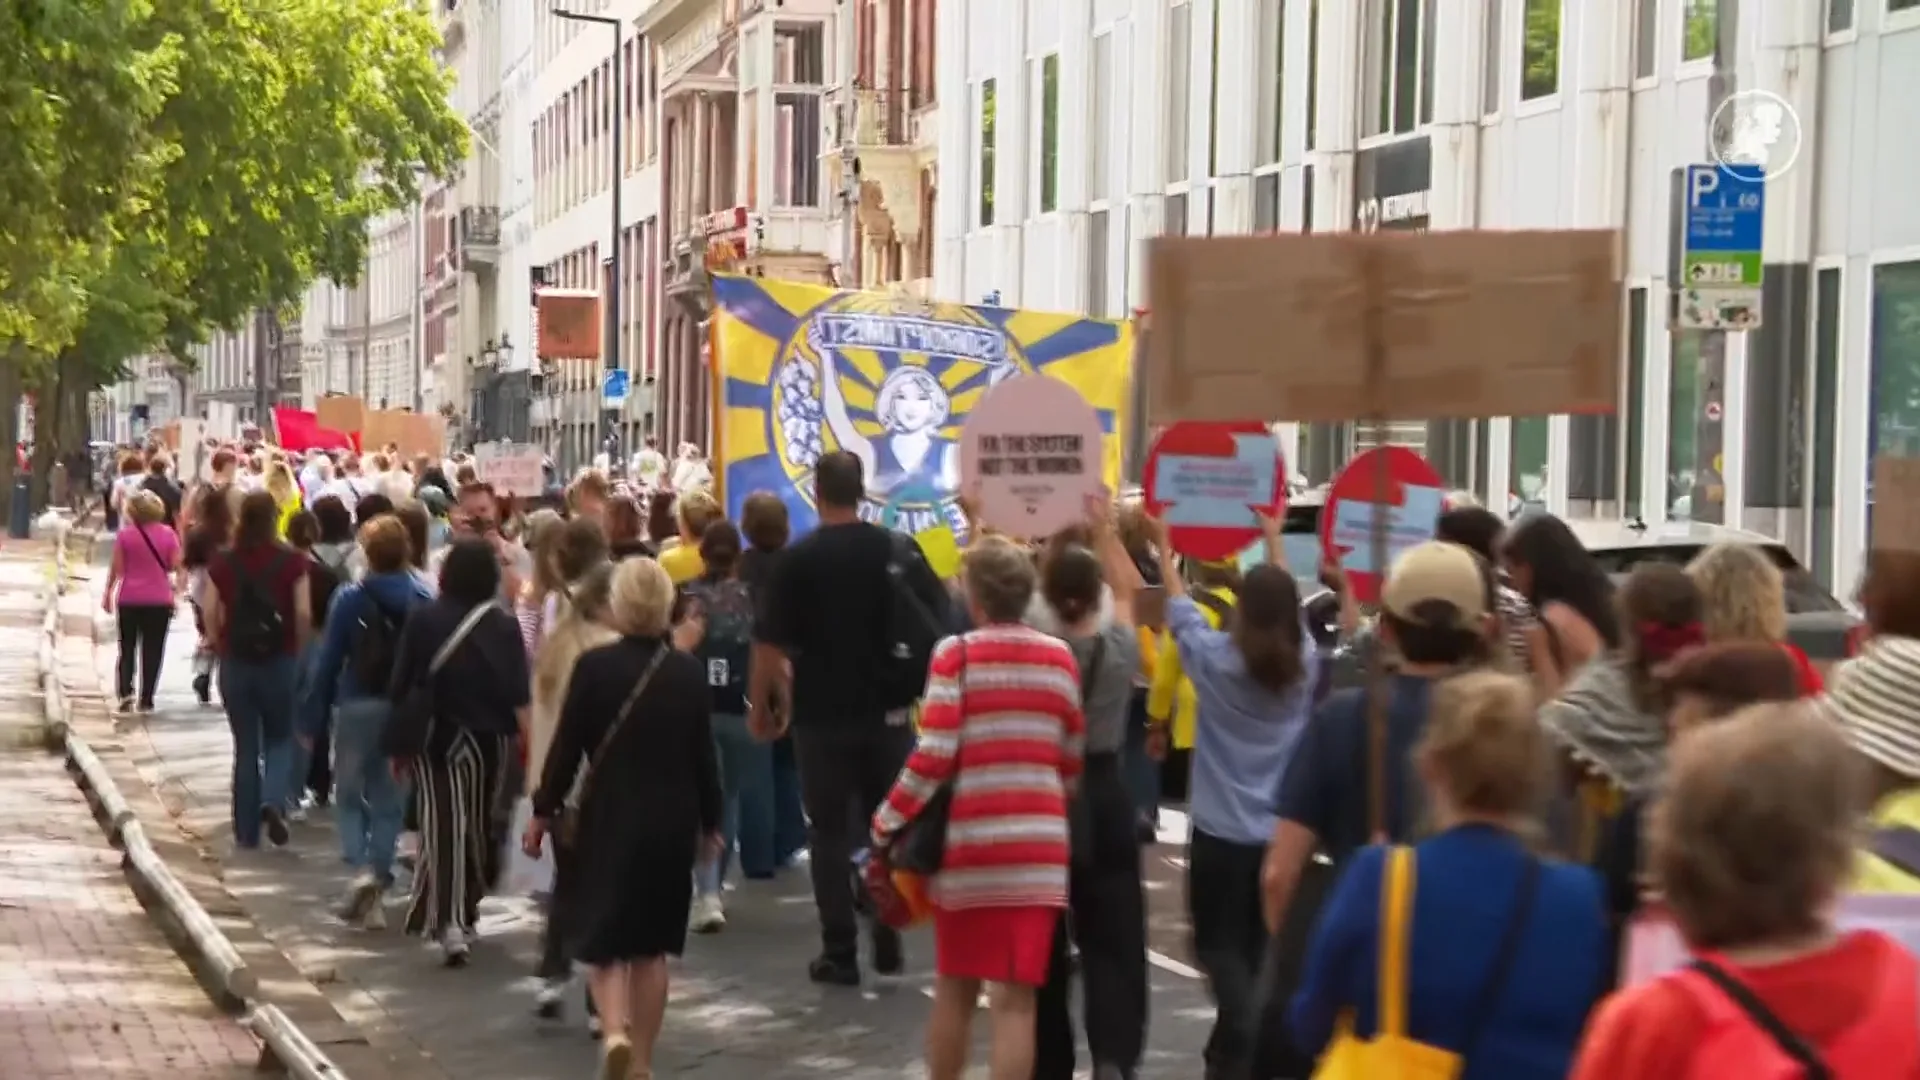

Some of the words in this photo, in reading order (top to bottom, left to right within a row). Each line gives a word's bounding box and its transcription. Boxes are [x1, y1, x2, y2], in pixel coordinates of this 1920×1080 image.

[1692, 168, 1719, 206] P
[1002, 434, 1026, 452] THE
[1028, 434, 1083, 453] SYSTEM
[978, 458, 1004, 475] NOT
[1006, 457, 1032, 475] THE
